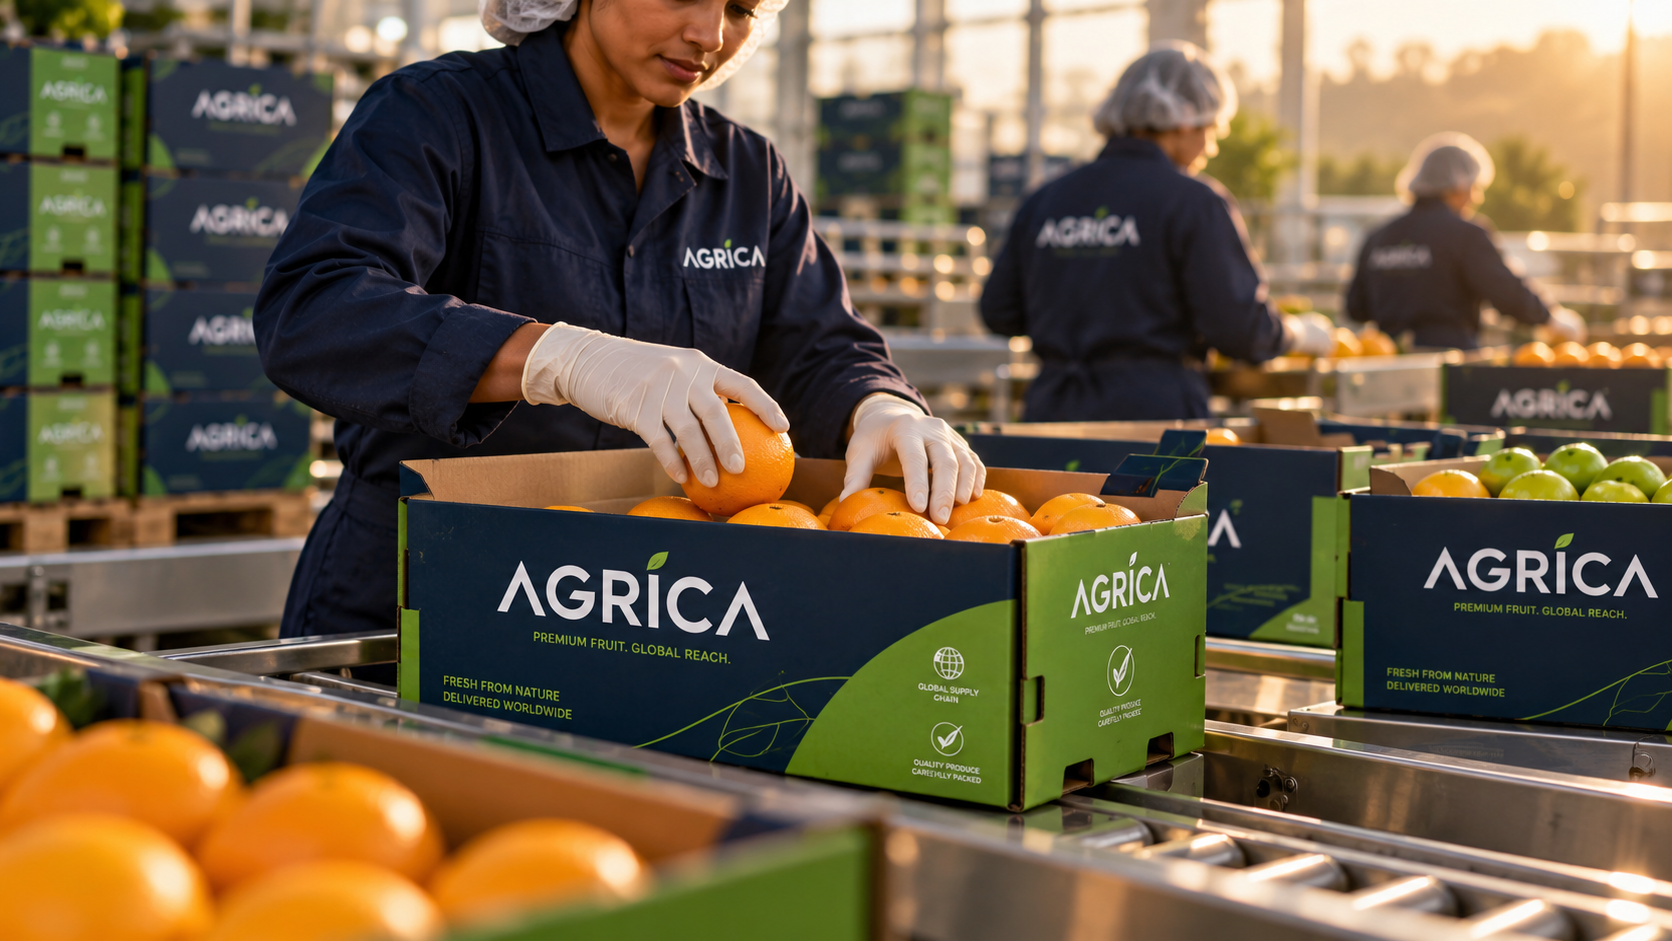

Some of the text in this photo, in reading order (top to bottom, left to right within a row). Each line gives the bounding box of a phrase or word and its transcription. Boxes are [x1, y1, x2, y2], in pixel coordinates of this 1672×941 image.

[191, 89, 297, 126] AGRICA
[683, 245, 766, 269] AGRICA
[1490, 388, 1612, 420] AGRICA
[1423, 546, 1659, 599] AGRICA
[497, 560, 770, 641] AGRICA
[1070, 563, 1170, 619] AGRICA
[1454, 602, 1628, 620] PREMIUM FRUIT. GLOBAL REACH.
[533, 631, 731, 665] PREMIUM FRUIT. GLOBAL REACH.
[1386, 667, 1496, 683] FRESH FROM NATURE
[443, 675, 560, 702] FRESH FROM NATURE
[918, 682, 979, 697] GLOBAL SUPPLY
[933, 694, 959, 704] CHAIN
[1386, 680, 1505, 698] DELIVERED WORLDWIDE
[443, 691, 572, 720] DELIVERED WORLDWIDE
[945, 762, 980, 775] PRODUCE
[952, 773, 982, 784] PACKED
